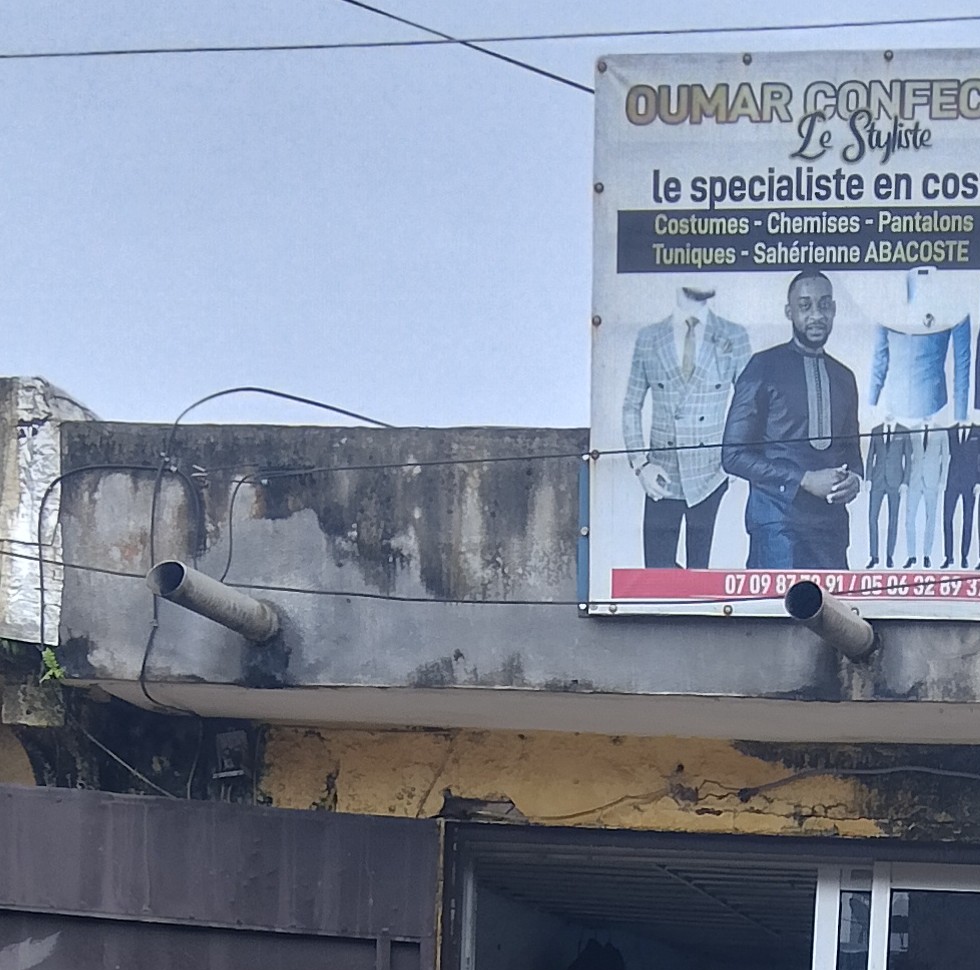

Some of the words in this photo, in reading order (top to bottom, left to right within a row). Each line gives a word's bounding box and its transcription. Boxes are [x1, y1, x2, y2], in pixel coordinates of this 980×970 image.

[626, 82, 793, 126] OUMAR
[790, 109, 833, 160] Le
[842, 107, 932, 164] Styliste
[653, 169, 681, 203] le
[690, 166, 864, 210] specialiste
[874, 172, 912, 200] en
[654, 213, 749, 235] Costumes
[767, 211, 860, 234] Chemises
[878, 210, 974, 233] Pantalons
[652, 242, 736, 269] Tuniques
[753, 240, 860, 264] Sahérienne
[864, 240, 970, 263] ABACOSTE
[725, 574, 747, 594] 07
[749, 574, 772, 595] 09
[825, 574, 844, 596] 91
[861, 575, 882, 595] 05
[886, 575, 909, 595] 06
[913, 575, 935, 595] 32
